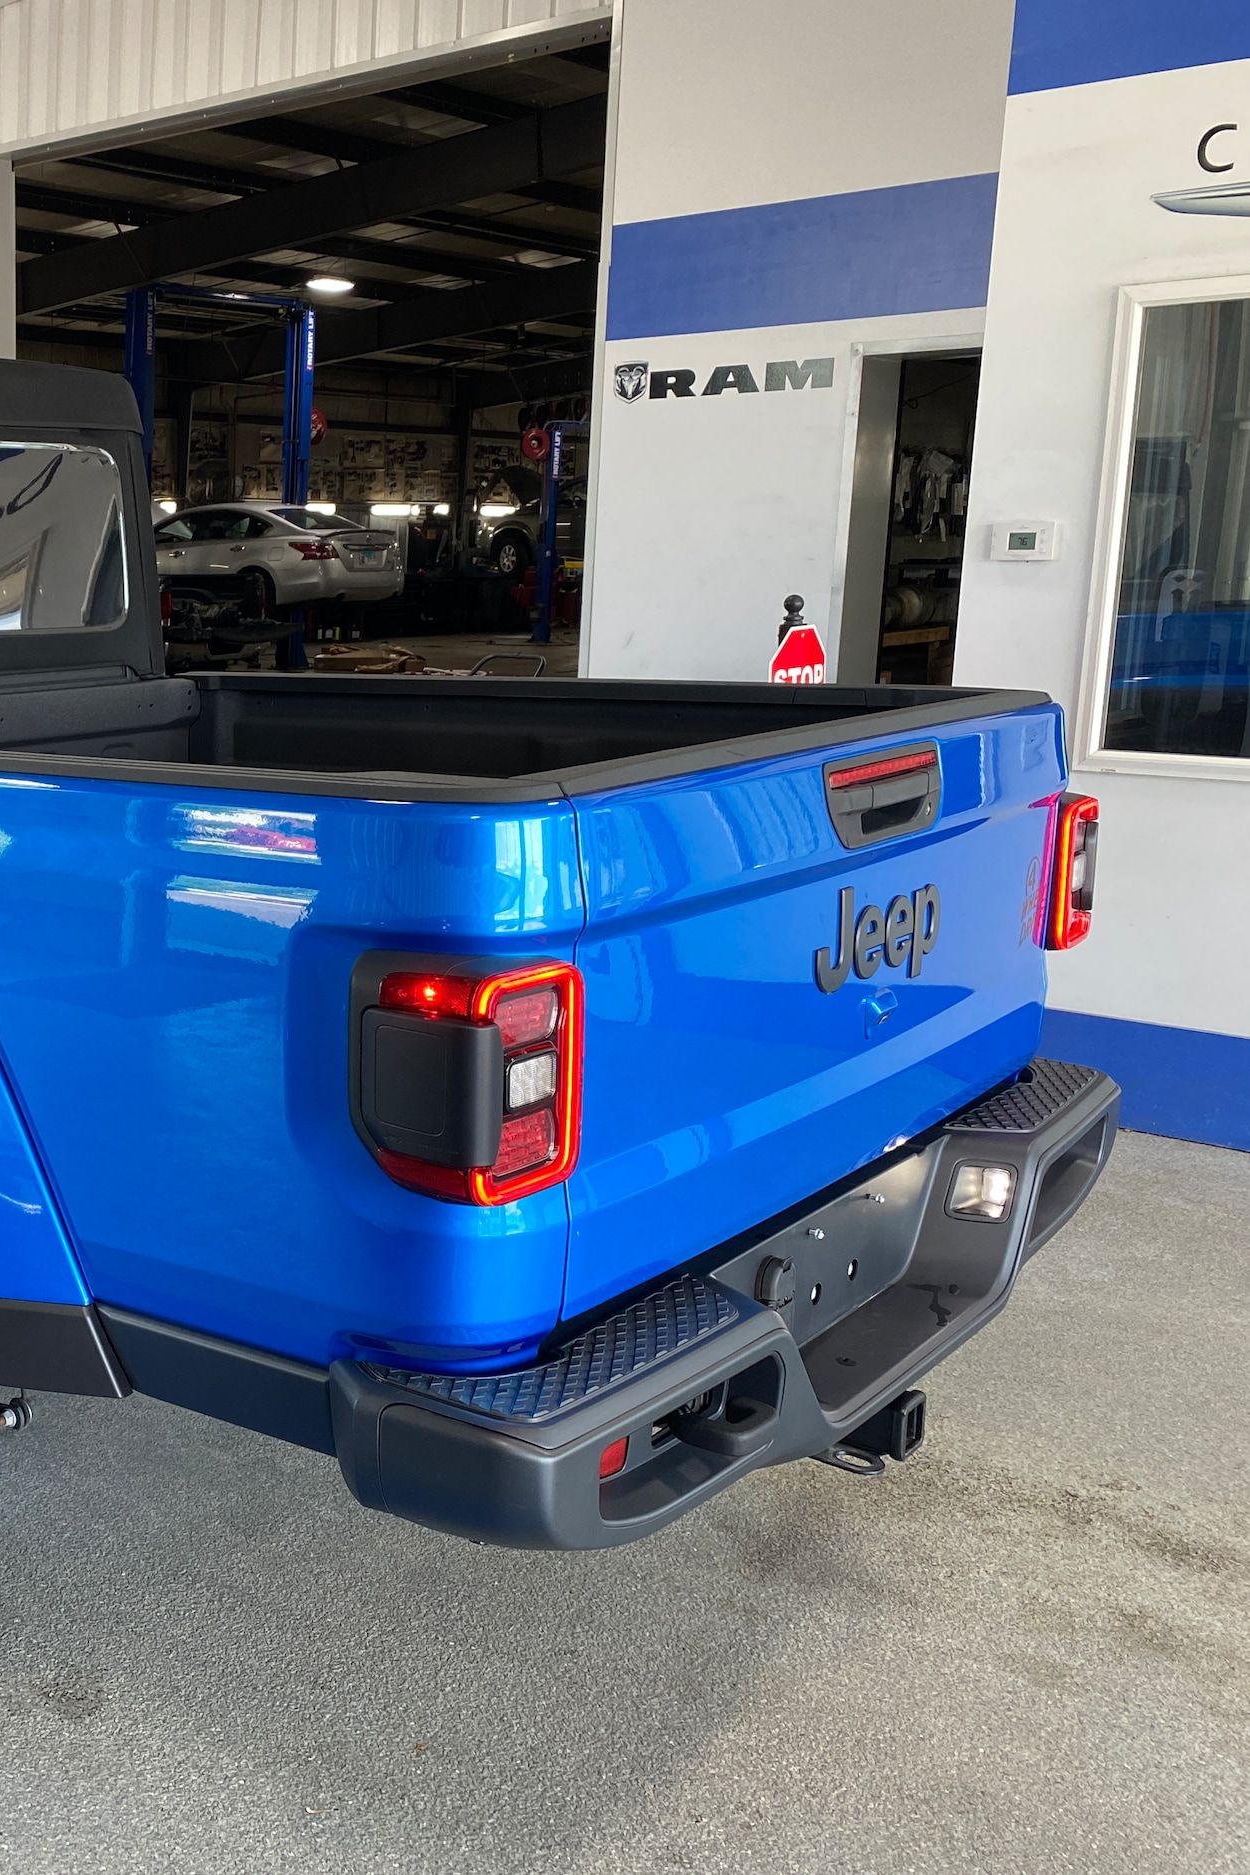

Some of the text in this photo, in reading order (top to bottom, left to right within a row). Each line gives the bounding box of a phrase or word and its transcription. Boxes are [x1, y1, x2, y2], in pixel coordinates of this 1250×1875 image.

[649, 357, 835, 399] RAM
[773, 663, 824, 684] STOP
[813, 883, 941, 995] Jeep
